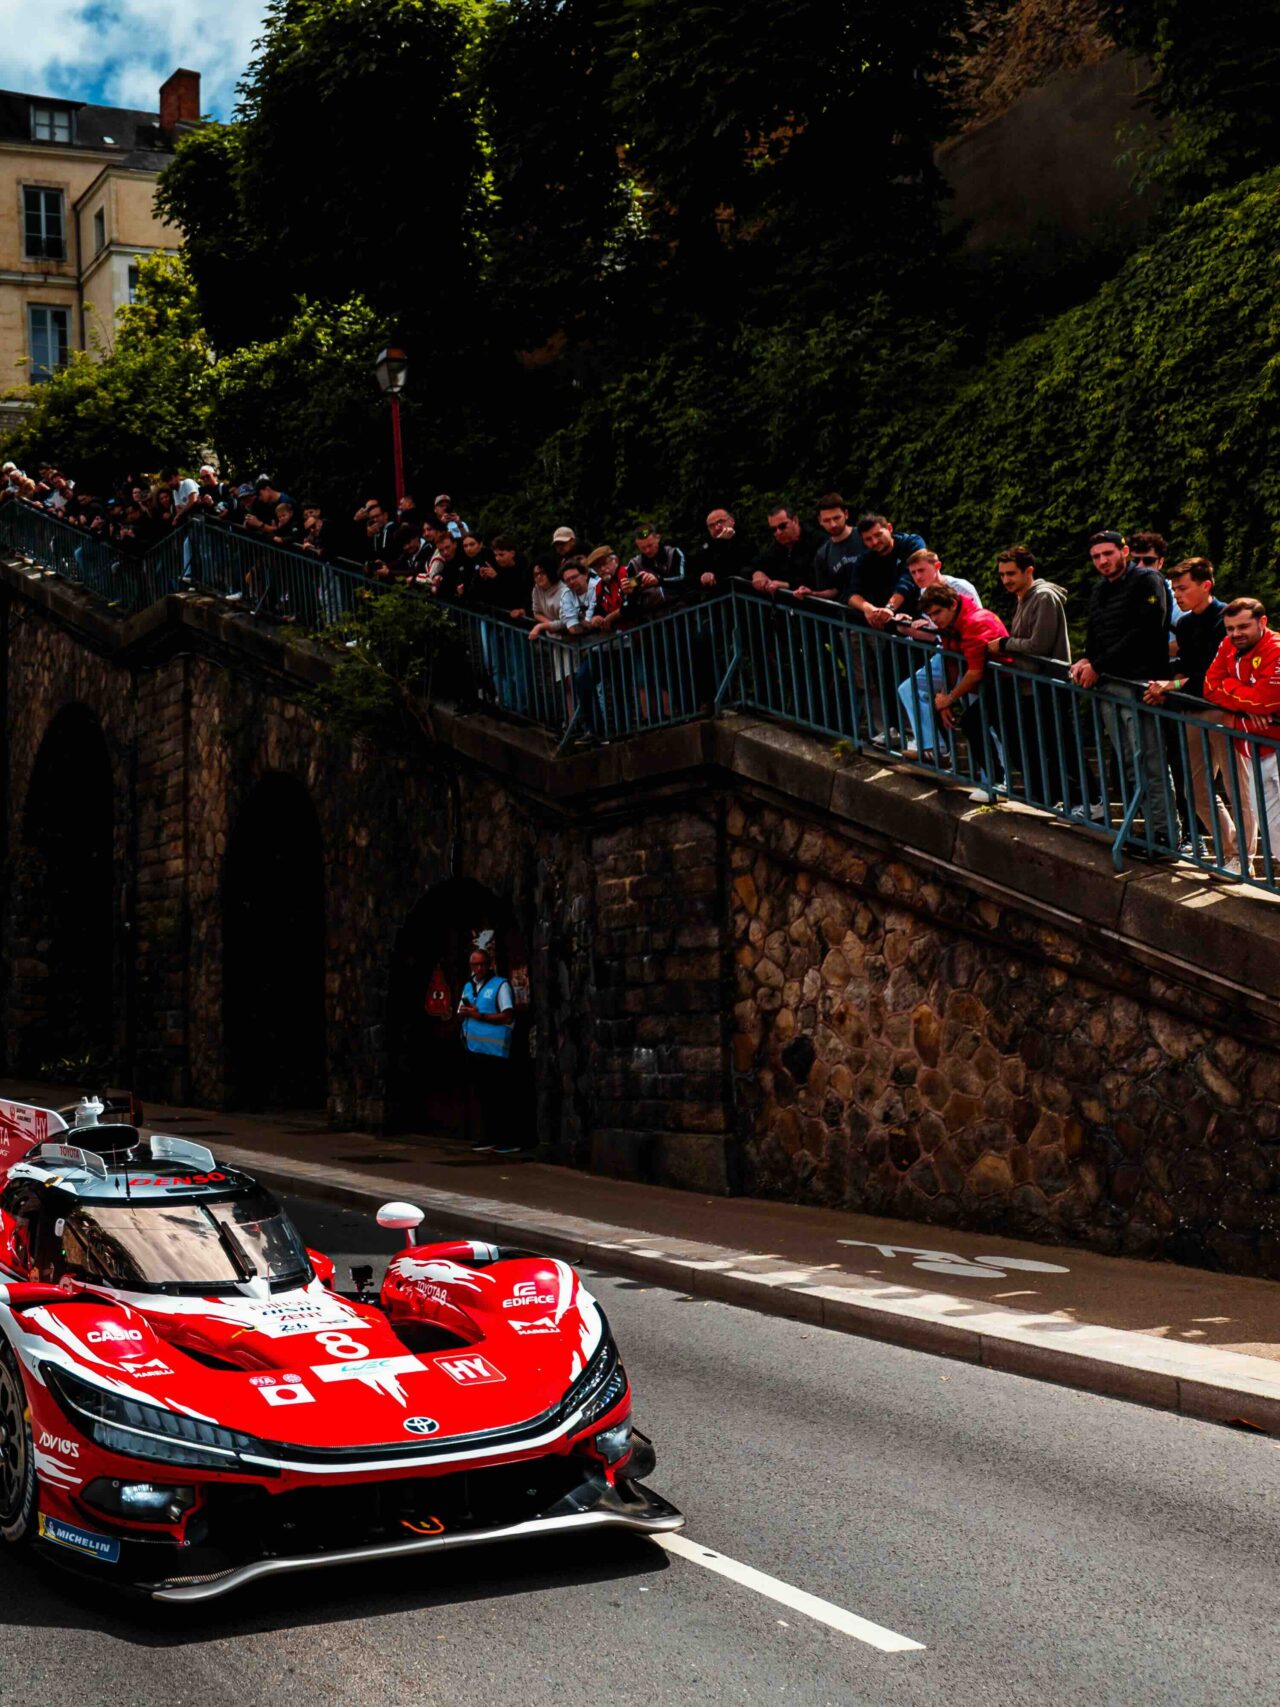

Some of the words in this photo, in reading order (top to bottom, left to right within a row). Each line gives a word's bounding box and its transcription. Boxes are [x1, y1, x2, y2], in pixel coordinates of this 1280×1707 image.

[36, 1116, 47, 1140] HY
[60, 1146, 80, 1160] TOYOTA
[129, 1172, 226, 1187] DENSO
[502, 1294, 555, 1308] EDIFICE
[87, 1329, 143, 1343] CASIO
[518, 1328, 561, 1336] MARELLI
[315, 1331, 370, 1360] 8
[441, 1357, 492, 1382] HY
[56, 1527, 111, 1553] MICHELIN
